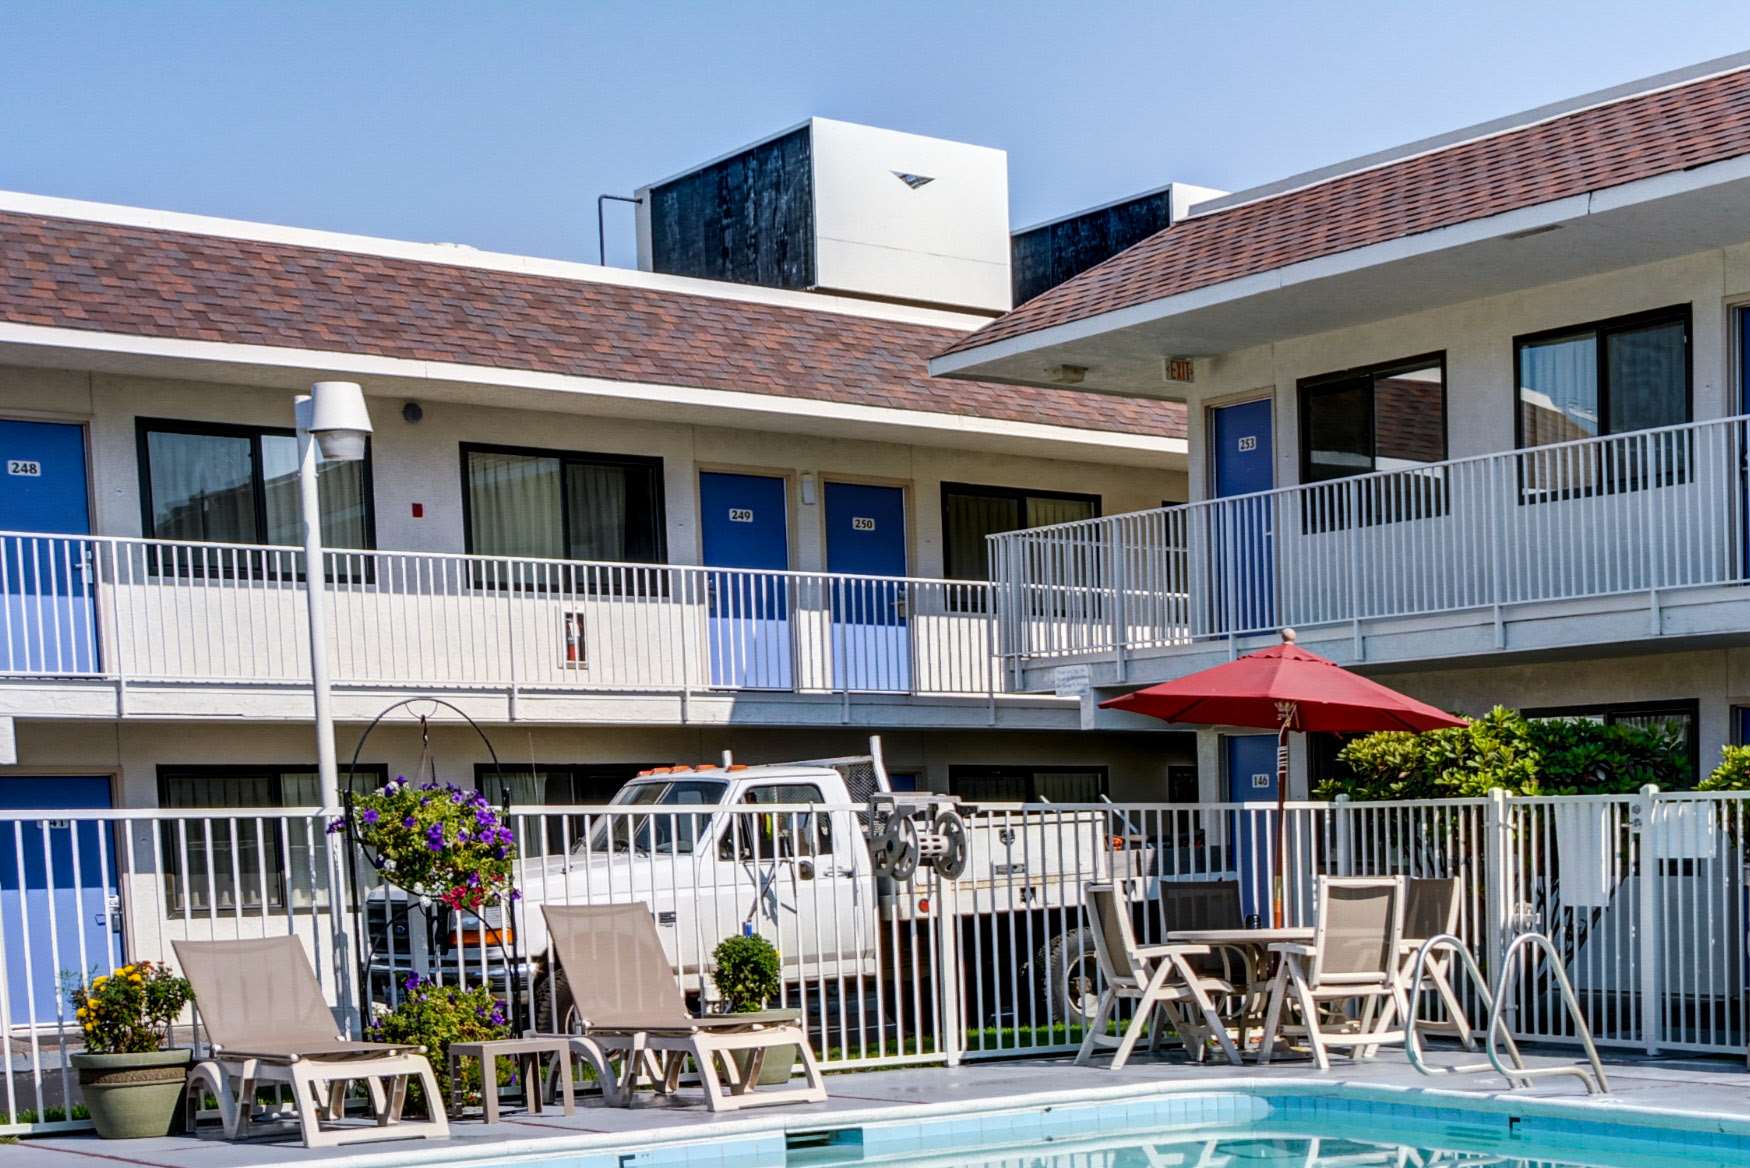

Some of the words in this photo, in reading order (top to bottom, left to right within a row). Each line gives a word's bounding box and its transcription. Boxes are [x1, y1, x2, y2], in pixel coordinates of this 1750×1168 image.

[11, 462, 38, 474] 248
[731, 510, 751, 520] 249
[855, 519, 873, 529] 250
